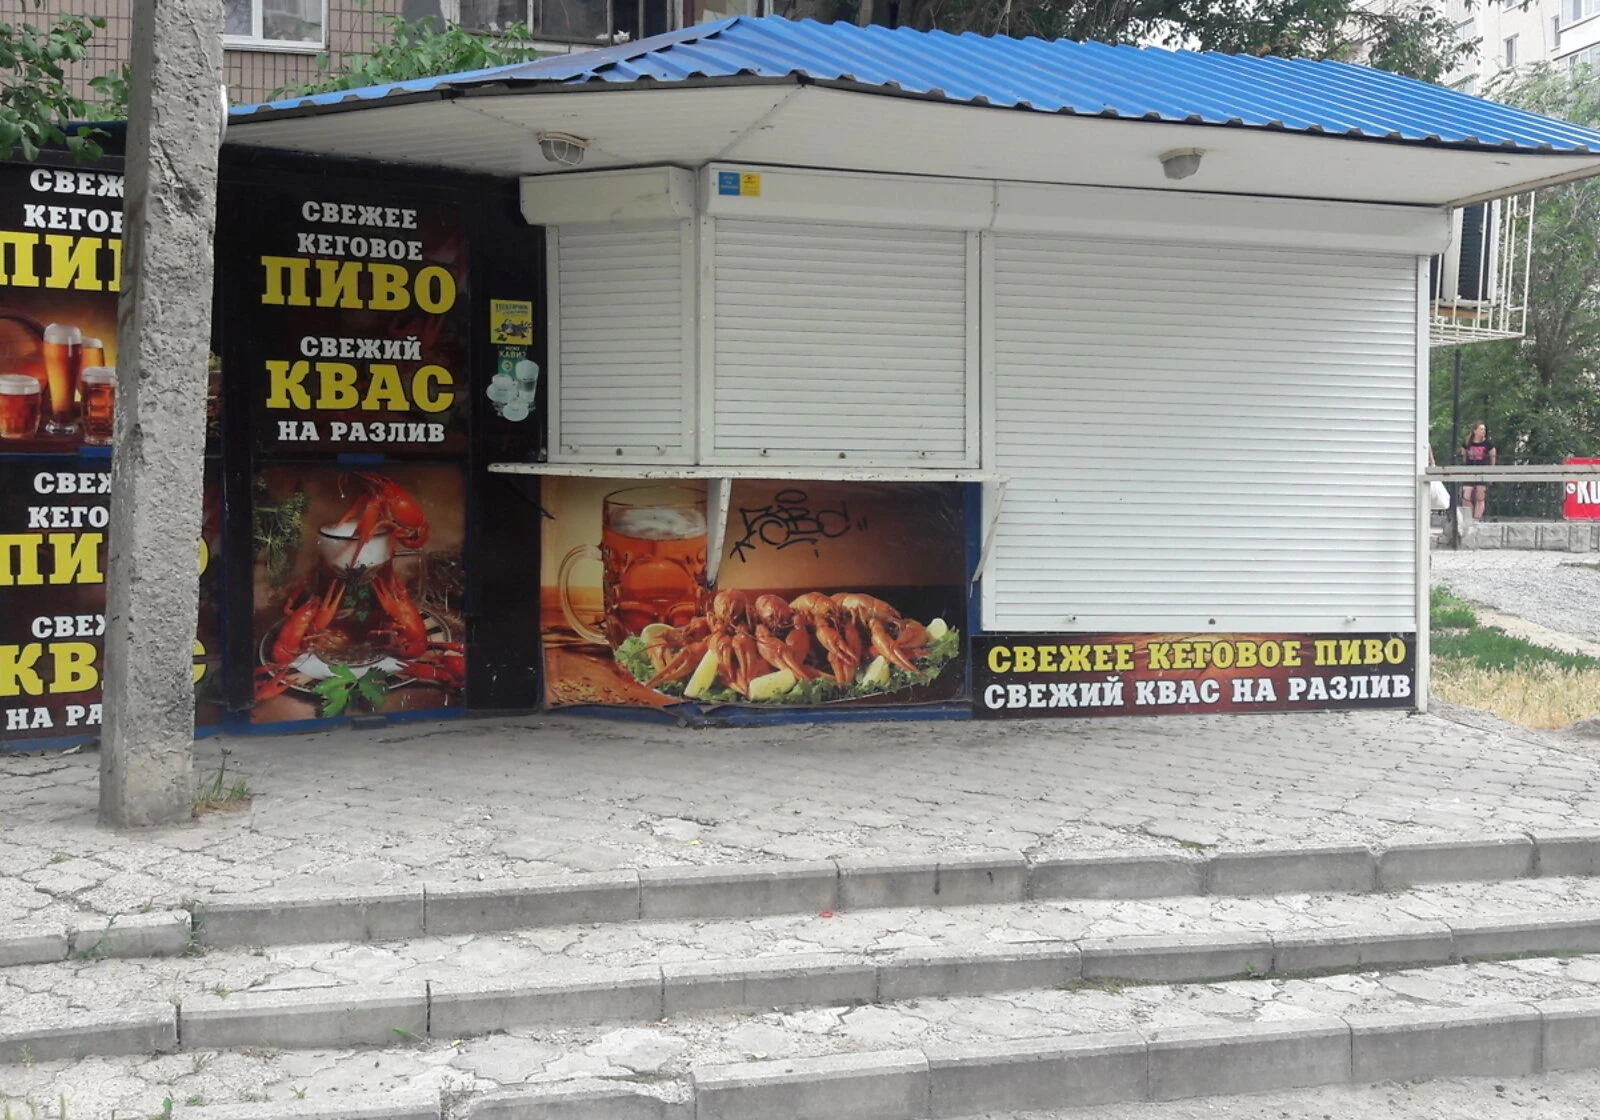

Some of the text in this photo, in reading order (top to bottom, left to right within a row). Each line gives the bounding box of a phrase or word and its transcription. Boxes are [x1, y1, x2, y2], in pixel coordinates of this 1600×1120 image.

[30, 169, 123, 198] СВЕЖ
[24, 204, 122, 232] КЕГО
[302, 201, 417, 229] СВЕЖЕЕ
[297, 233, 423, 260] КЕГОВОЕ
[0, 231, 121, 292] ПИ
[261, 255, 456, 314] ПИВО
[300, 336, 422, 361] СВЕЖИЙ
[266, 360, 454, 413] КВАС
[278, 421, 445, 442] НА РАЗЛИВ
[33, 472, 111, 494] СВЕ
[28, 507, 109, 529] КЕГО
[31, 616, 106, 638] СВЕ
[988, 638, 1406, 673] СВЕЖЕЕ КЕГОВОЕ ПИВО
[984, 675, 1411, 709] СВЕЖИЙ КВАС НА РАЗЛИВ
[6, 707, 53, 730] НА
